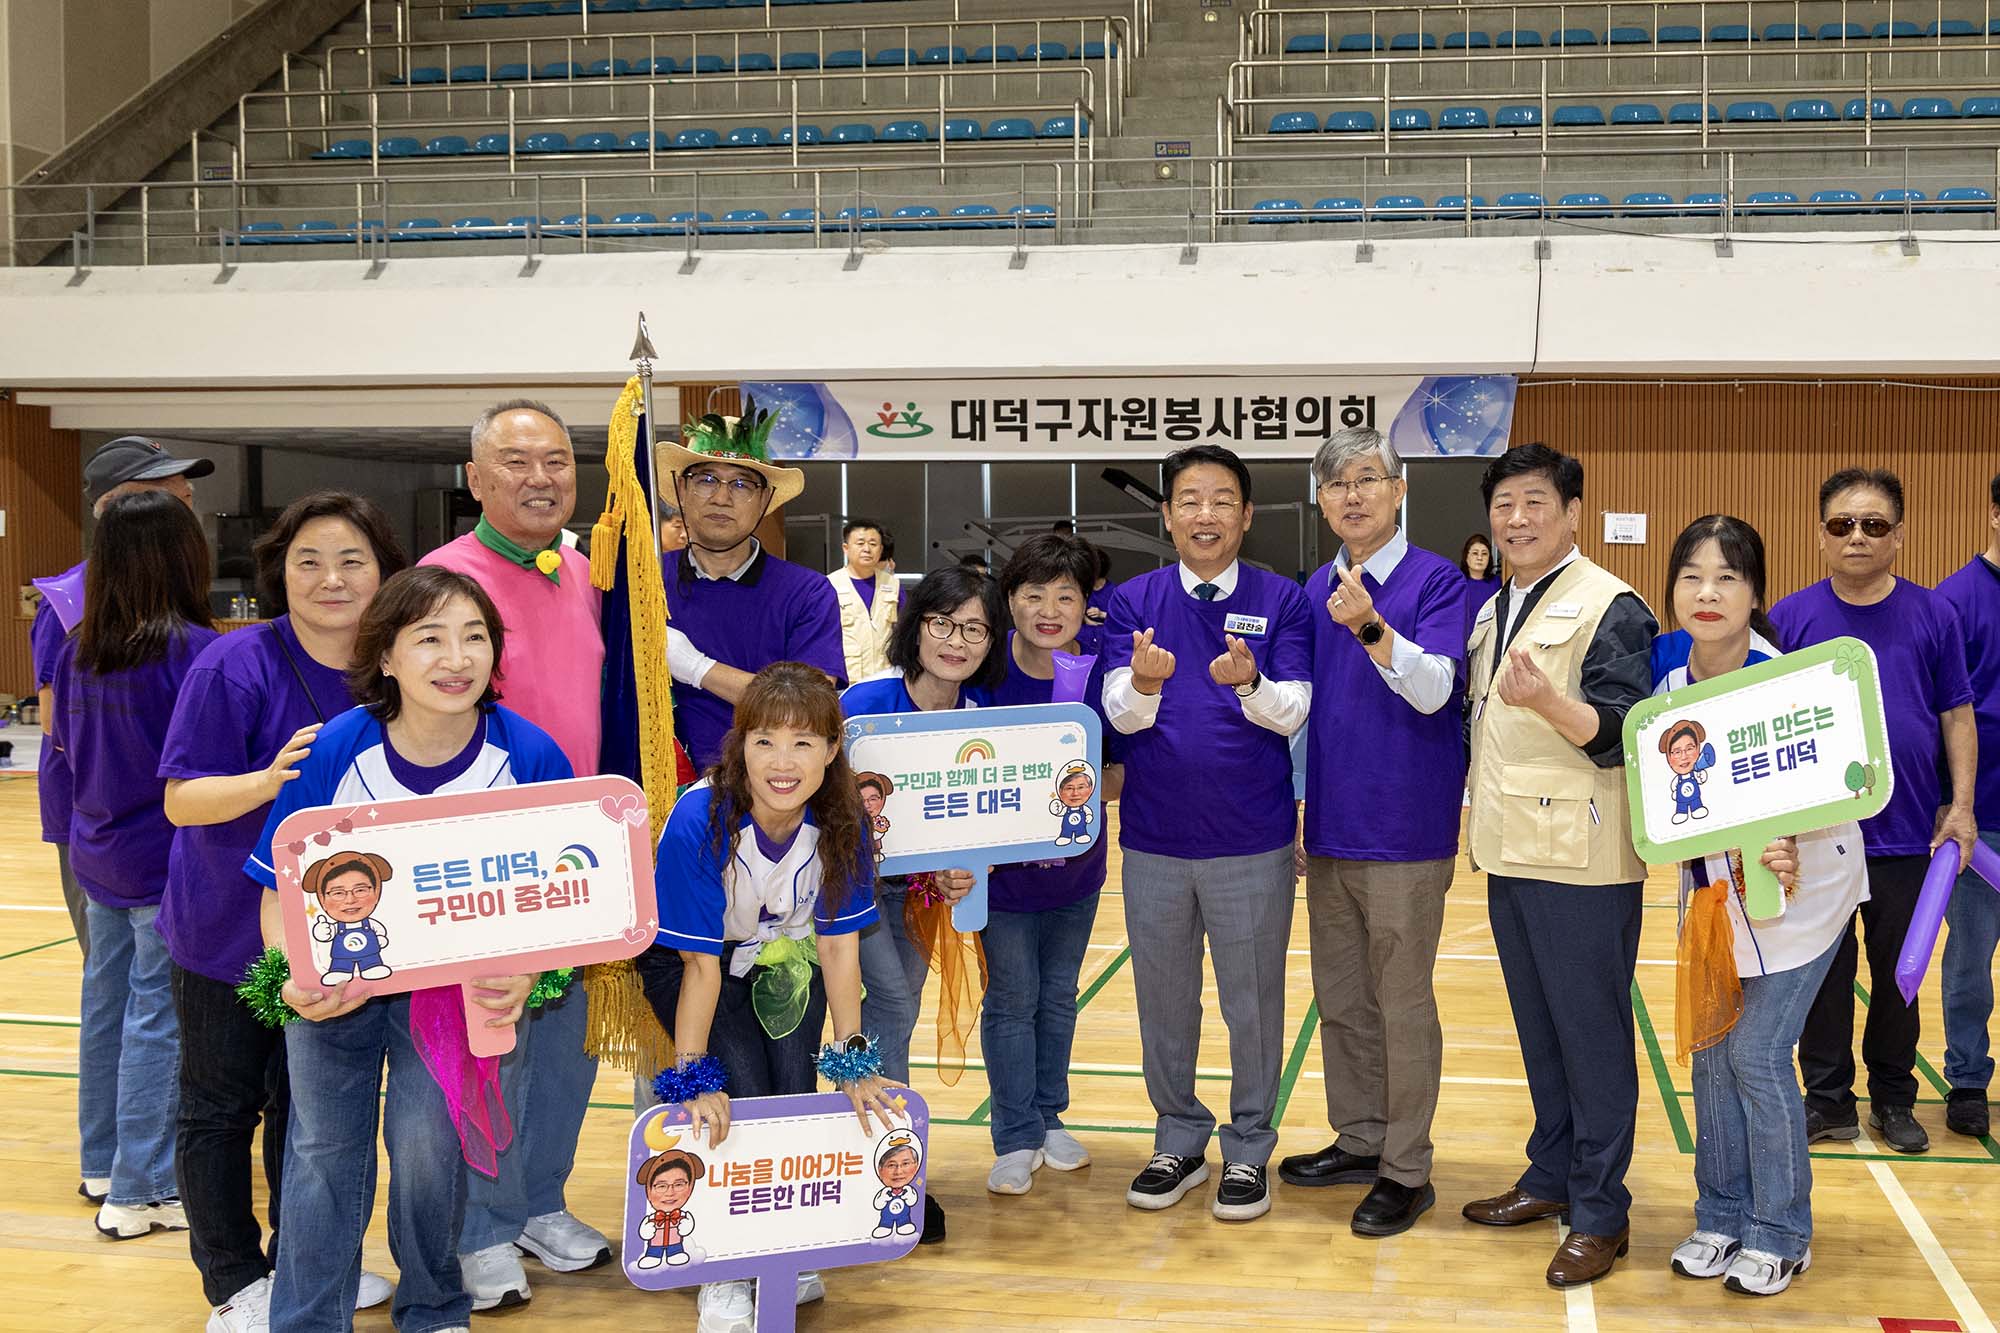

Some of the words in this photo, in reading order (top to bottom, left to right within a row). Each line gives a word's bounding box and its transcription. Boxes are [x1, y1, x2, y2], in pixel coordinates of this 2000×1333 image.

[951, 395, 1376, 441] 대덕구자원봉사협의회
[1727, 721, 1767, 754] 함께
[1773, 706, 1834, 741] 만드는
[894, 771, 942, 791] 구민과
[947, 768, 977, 788] 함께
[982, 766, 998, 784] 더
[1003, 766, 1018, 783] 큰
[1022, 763, 1053, 782] 변화
[1731, 752, 1770, 784] 든든
[1776, 739, 1817, 771] 대덕
[922, 792, 969, 819] 든든
[977, 787, 1021, 814] 대덕
[413, 859, 472, 892] 든든
[481, 851, 547, 882] 대덕,
[417, 889, 505, 925] 구민이
[514, 878, 590, 913] 중심!!
[708, 1158, 774, 1188] 나눔을
[781, 1152, 863, 1181] 이어가는
[729, 1185, 795, 1215] 든든한
[801, 1180, 842, 1207] 대덕
